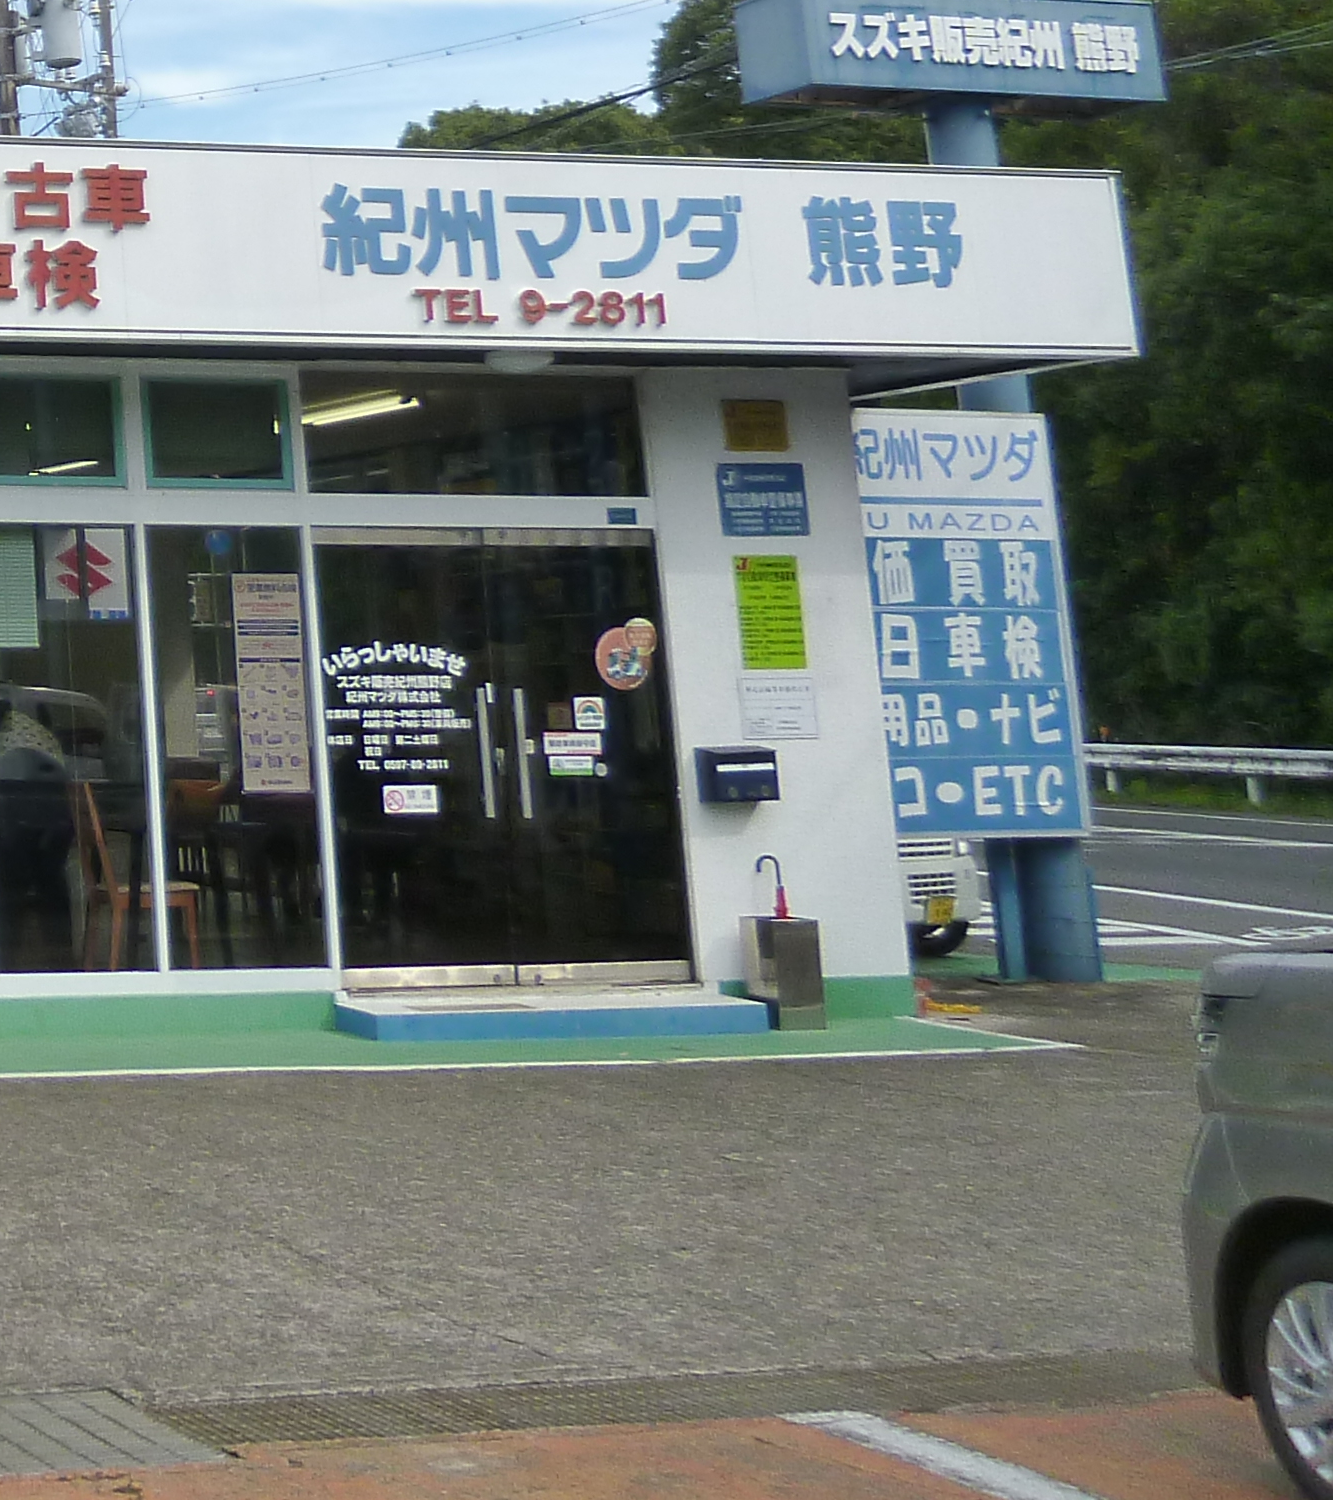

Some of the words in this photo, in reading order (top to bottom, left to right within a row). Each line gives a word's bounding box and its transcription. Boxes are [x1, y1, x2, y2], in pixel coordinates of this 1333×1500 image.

[829, 12, 1065, 70] スズキ販売紀州
[1071, 22, 1139, 74] 熊野
[320, 182, 742, 281] 紀州マツダ
[801, 196, 964, 288] 熊野
[411, 288, 499, 324] TEL
[518, 289, 668, 328] 9-2811
[867, 512, 889, 531] U
[907, 512, 1040, 533] MAZDA
[321, 640, 467, 676] いらっしゃいませ
[882, 687, 1063, 747] 用品・ナビ
[894, 765, 1064, 818] コ・ETC
